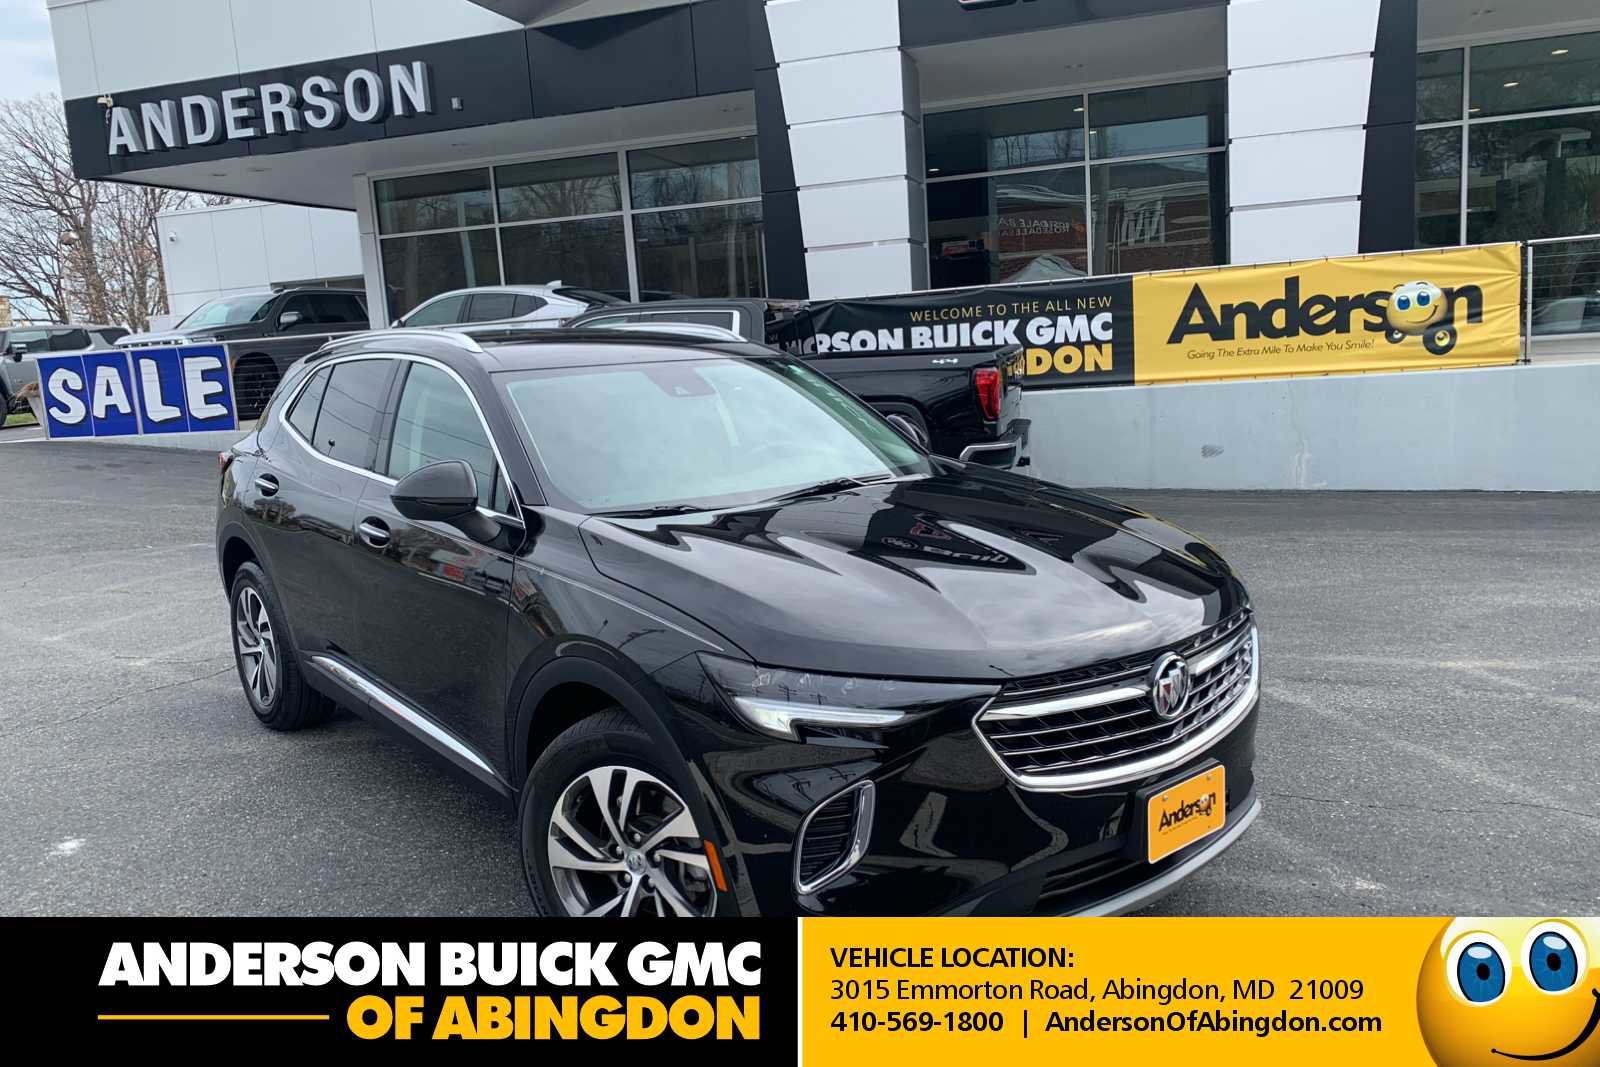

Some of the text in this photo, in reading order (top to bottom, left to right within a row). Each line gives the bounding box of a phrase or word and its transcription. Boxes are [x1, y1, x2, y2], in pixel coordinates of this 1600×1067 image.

[109, 61, 433, 155] ANDERSON
[910, 296, 1112, 322] WELCOME TO THE ALL NEW
[911, 318, 1021, 350] BUICK
[1026, 312, 1113, 345] GMC
[1026, 343, 1113, 376] DON
[1187, 339, 1375, 360] Going The Extra Mile To Make You Smile!
[48, 356, 228, 424] SALE
